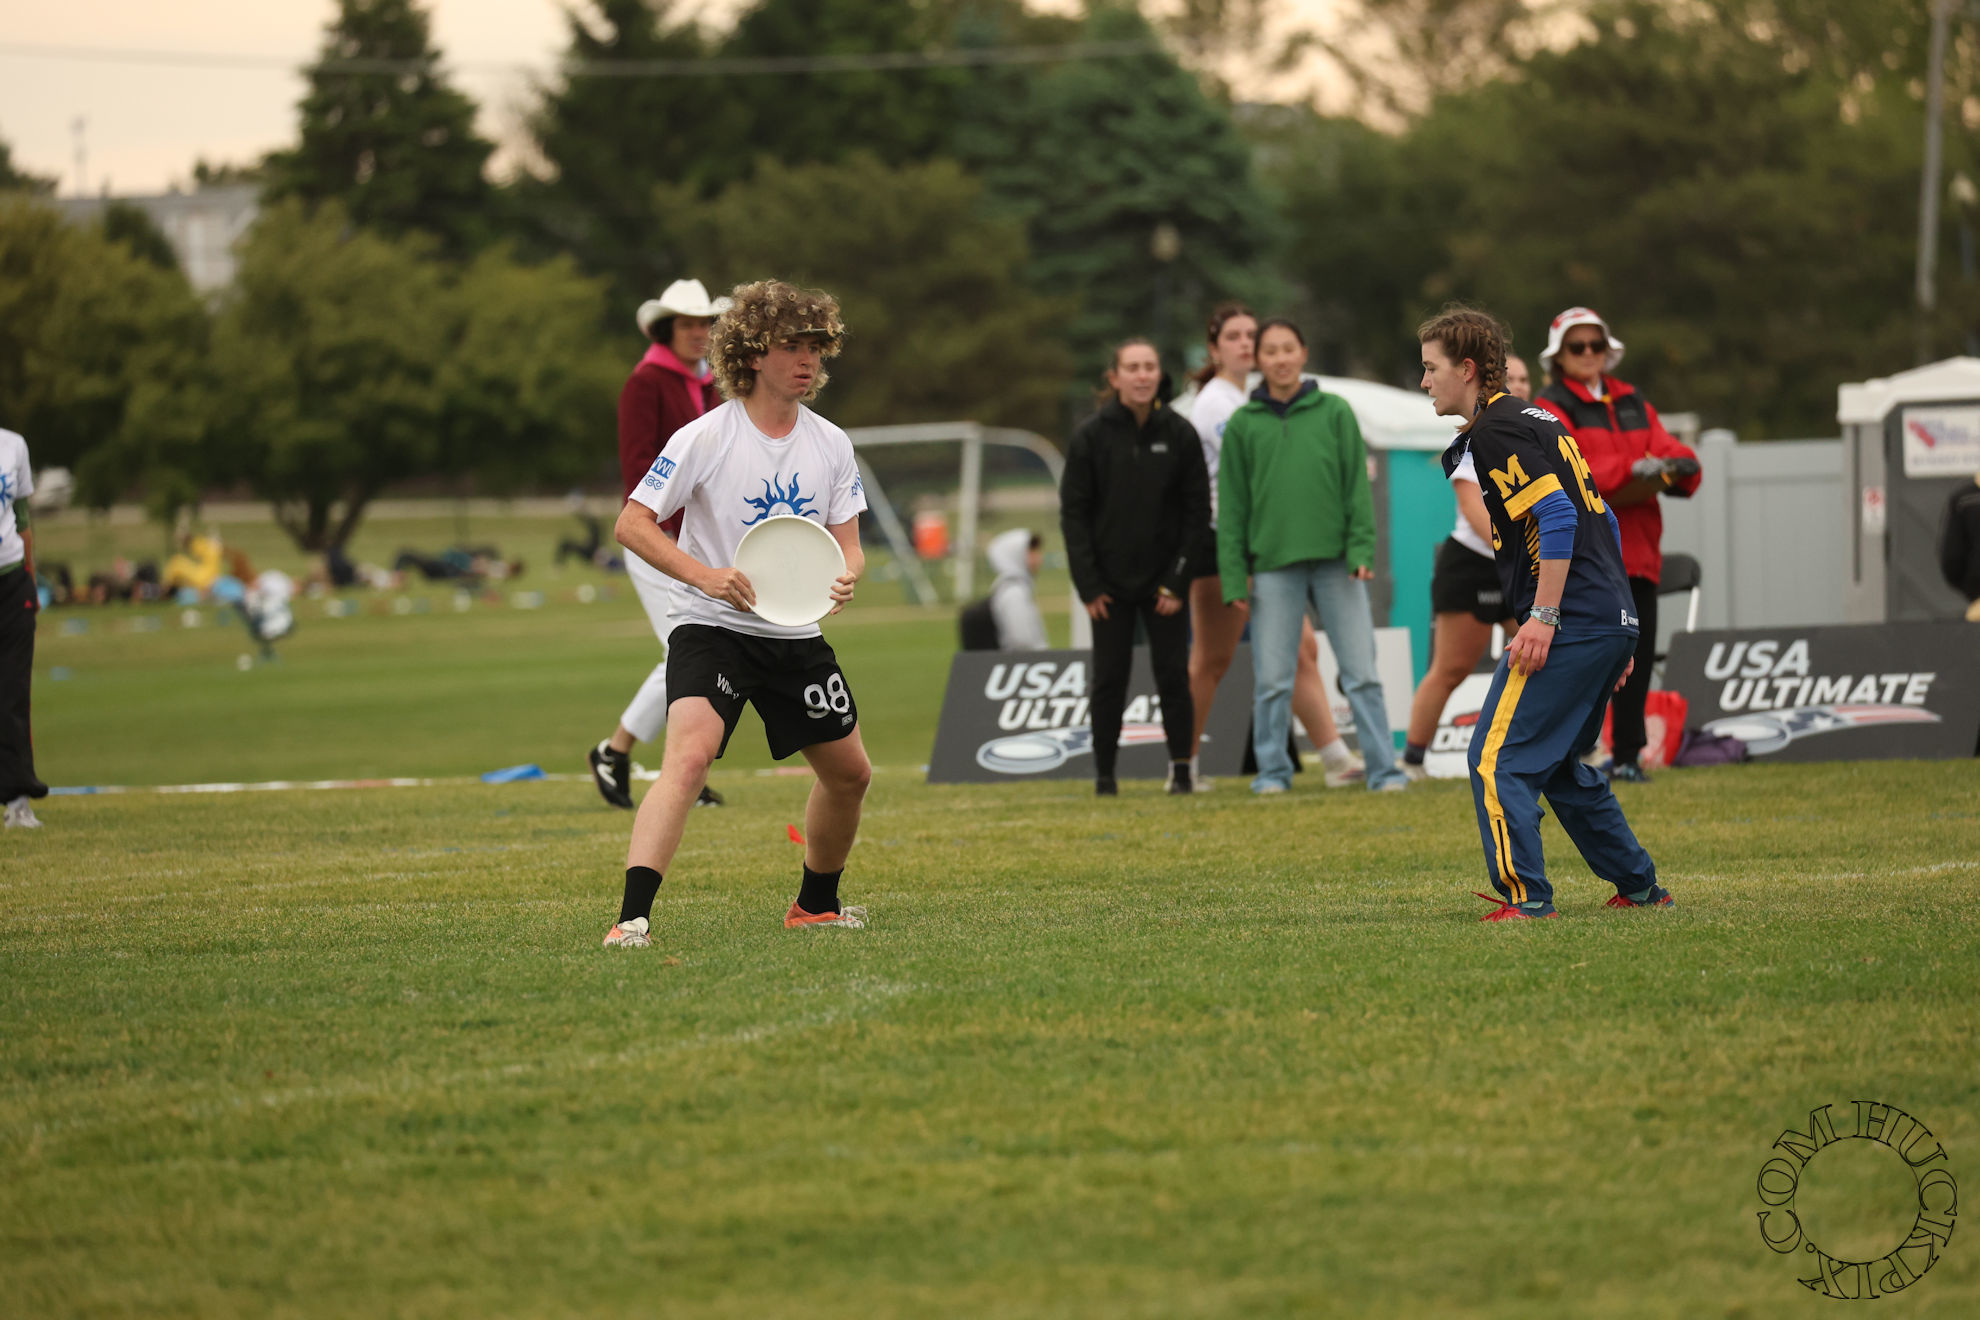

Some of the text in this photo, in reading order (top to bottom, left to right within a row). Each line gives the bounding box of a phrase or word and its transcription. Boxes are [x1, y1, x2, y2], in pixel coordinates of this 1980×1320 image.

[1488, 453, 1531, 500] M
[1558, 435, 1606, 514] 15
[984, 661, 1087, 701] USA
[1704, 639, 1810, 681] USA
[804, 672, 850, 719] 98
[1718, 671, 1936, 712] ULTIMATE
